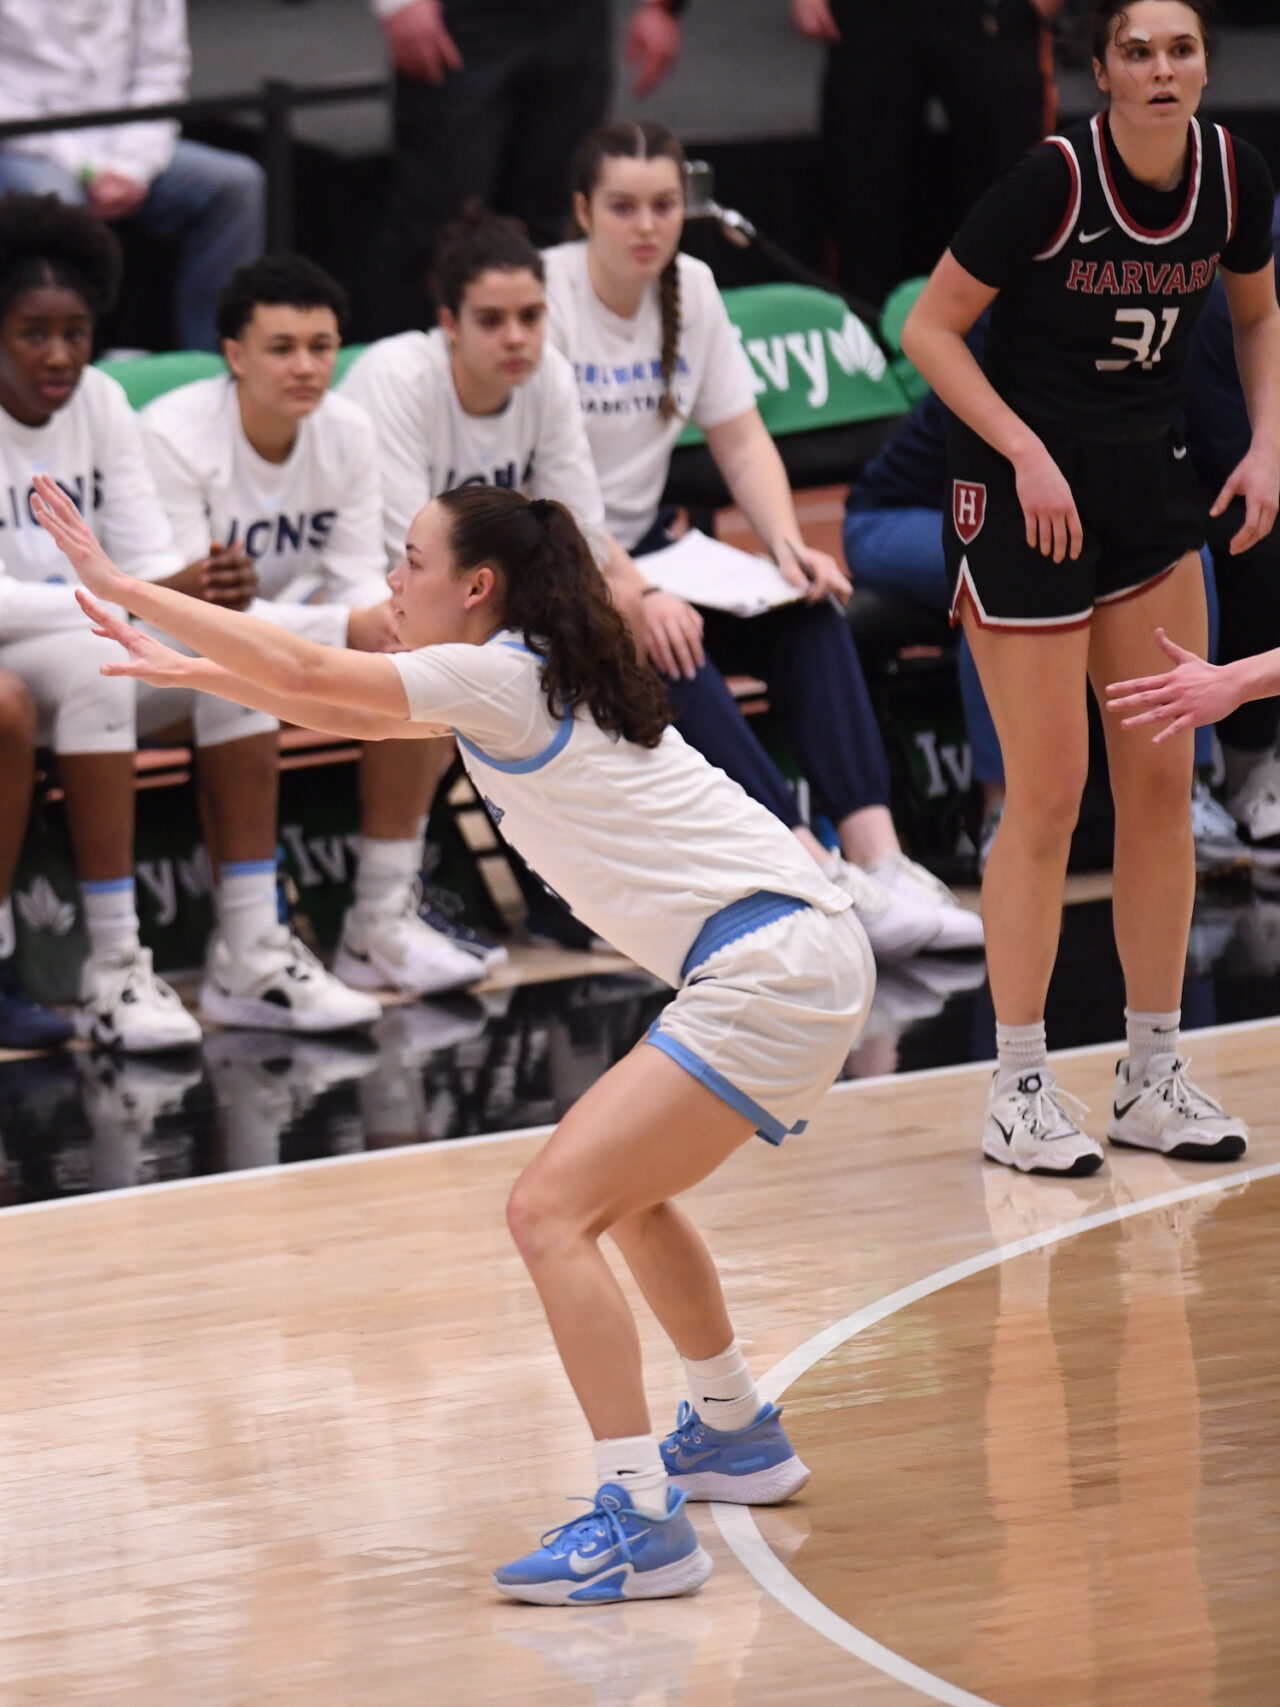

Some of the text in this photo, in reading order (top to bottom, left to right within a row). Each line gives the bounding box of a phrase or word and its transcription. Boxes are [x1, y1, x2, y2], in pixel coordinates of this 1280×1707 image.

[1095, 307, 1180, 371] 31
[957, 489, 977, 526] H
[915, 731, 972, 797] Iv
[282, 824, 362, 886] Iv
